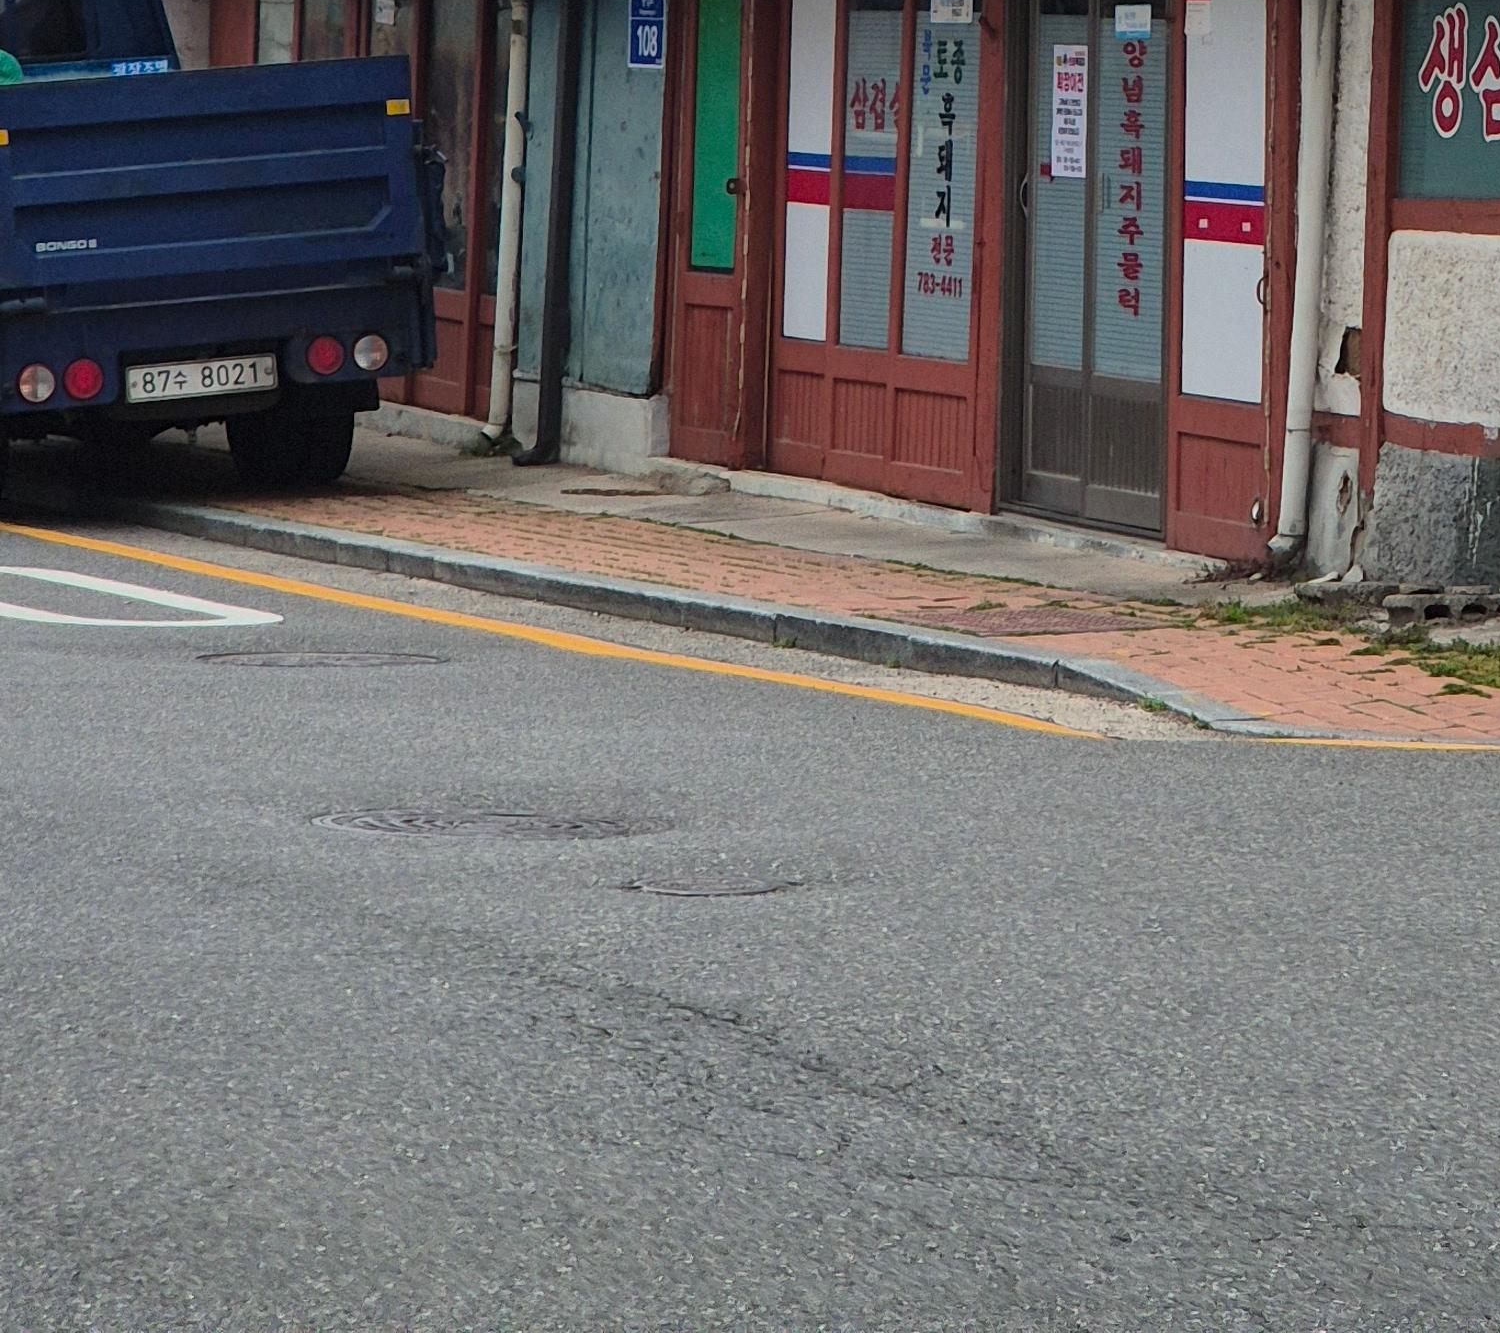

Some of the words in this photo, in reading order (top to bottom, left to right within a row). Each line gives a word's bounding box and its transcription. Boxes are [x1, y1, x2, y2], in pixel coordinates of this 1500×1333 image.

[637, 25, 658, 57] 108
[933, 39, 966, 85] 토종
[935, 92, 956, 228] 흑돼지
[35, 239, 87, 253] BONGO
[930, 234, 955, 267] 전문
[917, 271, 963, 299] 783-4411
[142, 369, 187, 394] 87수
[201, 361, 259, 388] 8021
